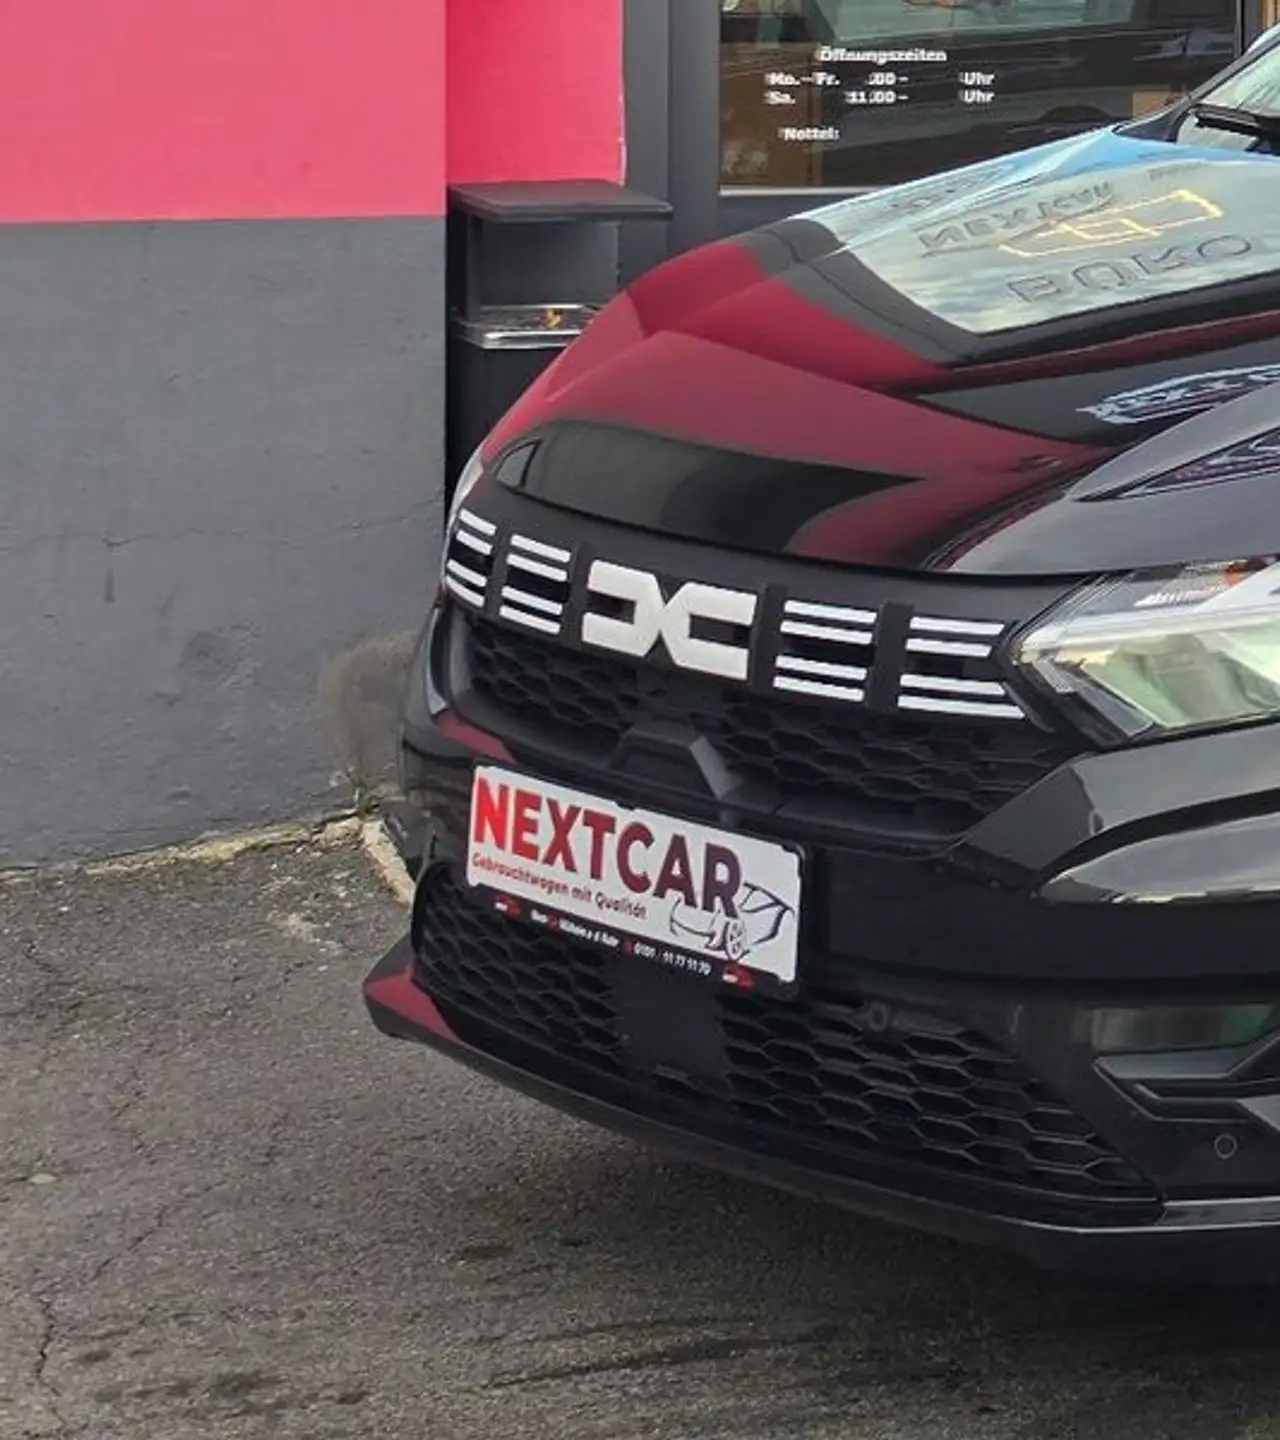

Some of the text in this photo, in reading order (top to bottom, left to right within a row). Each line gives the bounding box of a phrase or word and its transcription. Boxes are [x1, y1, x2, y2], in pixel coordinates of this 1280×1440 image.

[817, 44, 948, 66] Öffnungszeiten
[959, 71, 995, 86] Uhr
[764, 91, 796, 104] Sa.
[959, 90, 995, 104] Uhr
[472, 776, 742, 920] NEXTCAR
[471, 851, 570, 895] Gebrauchtwagen
[571, 886, 593, 903] mit
